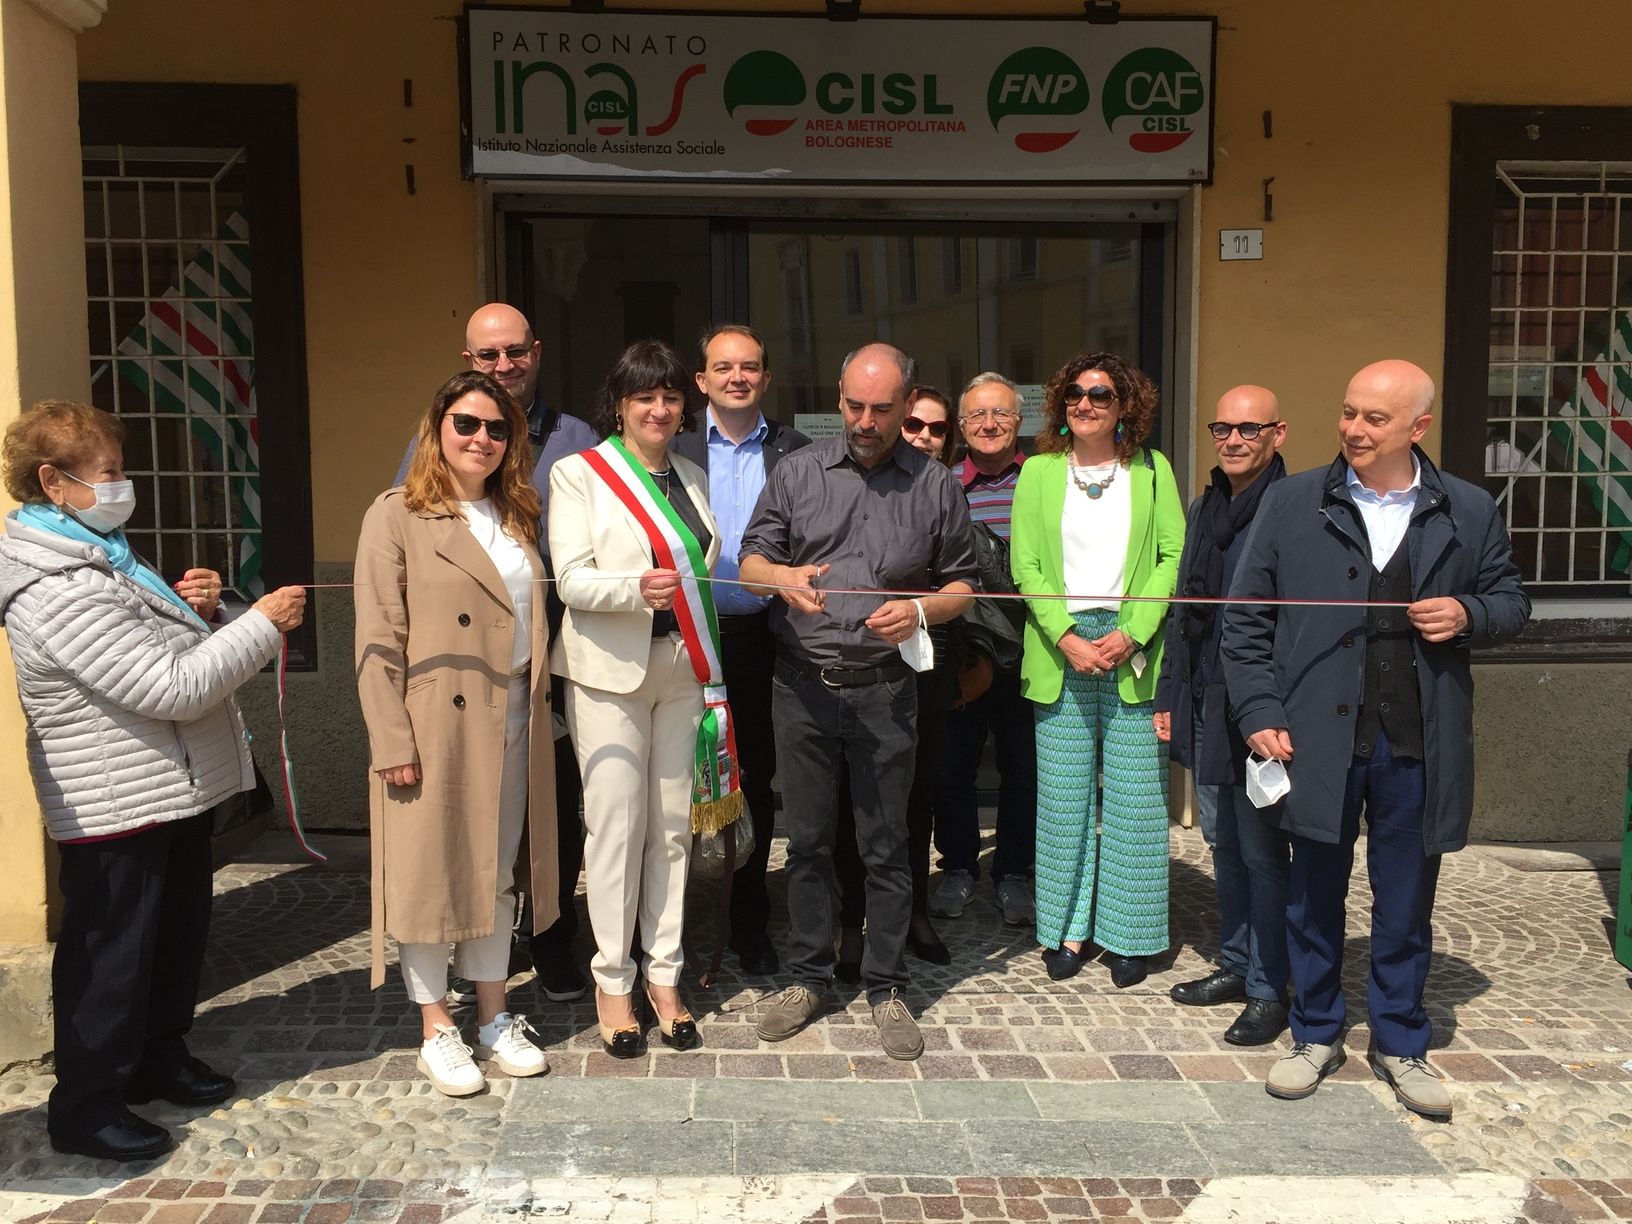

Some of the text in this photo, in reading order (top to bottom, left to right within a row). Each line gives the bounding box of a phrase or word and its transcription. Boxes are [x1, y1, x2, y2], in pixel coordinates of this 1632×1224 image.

[492, 32, 707, 56] PATRONATO
[815, 72, 954, 115] CISL
[999, 74, 1078, 104] FNP
[1125, 71, 1200, 110] CAF
[587, 100, 625, 114] CISL
[805, 119, 967, 133] AREA METROPOLITANA
[1142, 116, 1191, 132] CISL
[477, 138, 725, 155] Istituto Nazionale Assistenza Sociale
[805, 135, 893, 148] BOLOGNESE
[1234, 235, 1249, 253] 11
